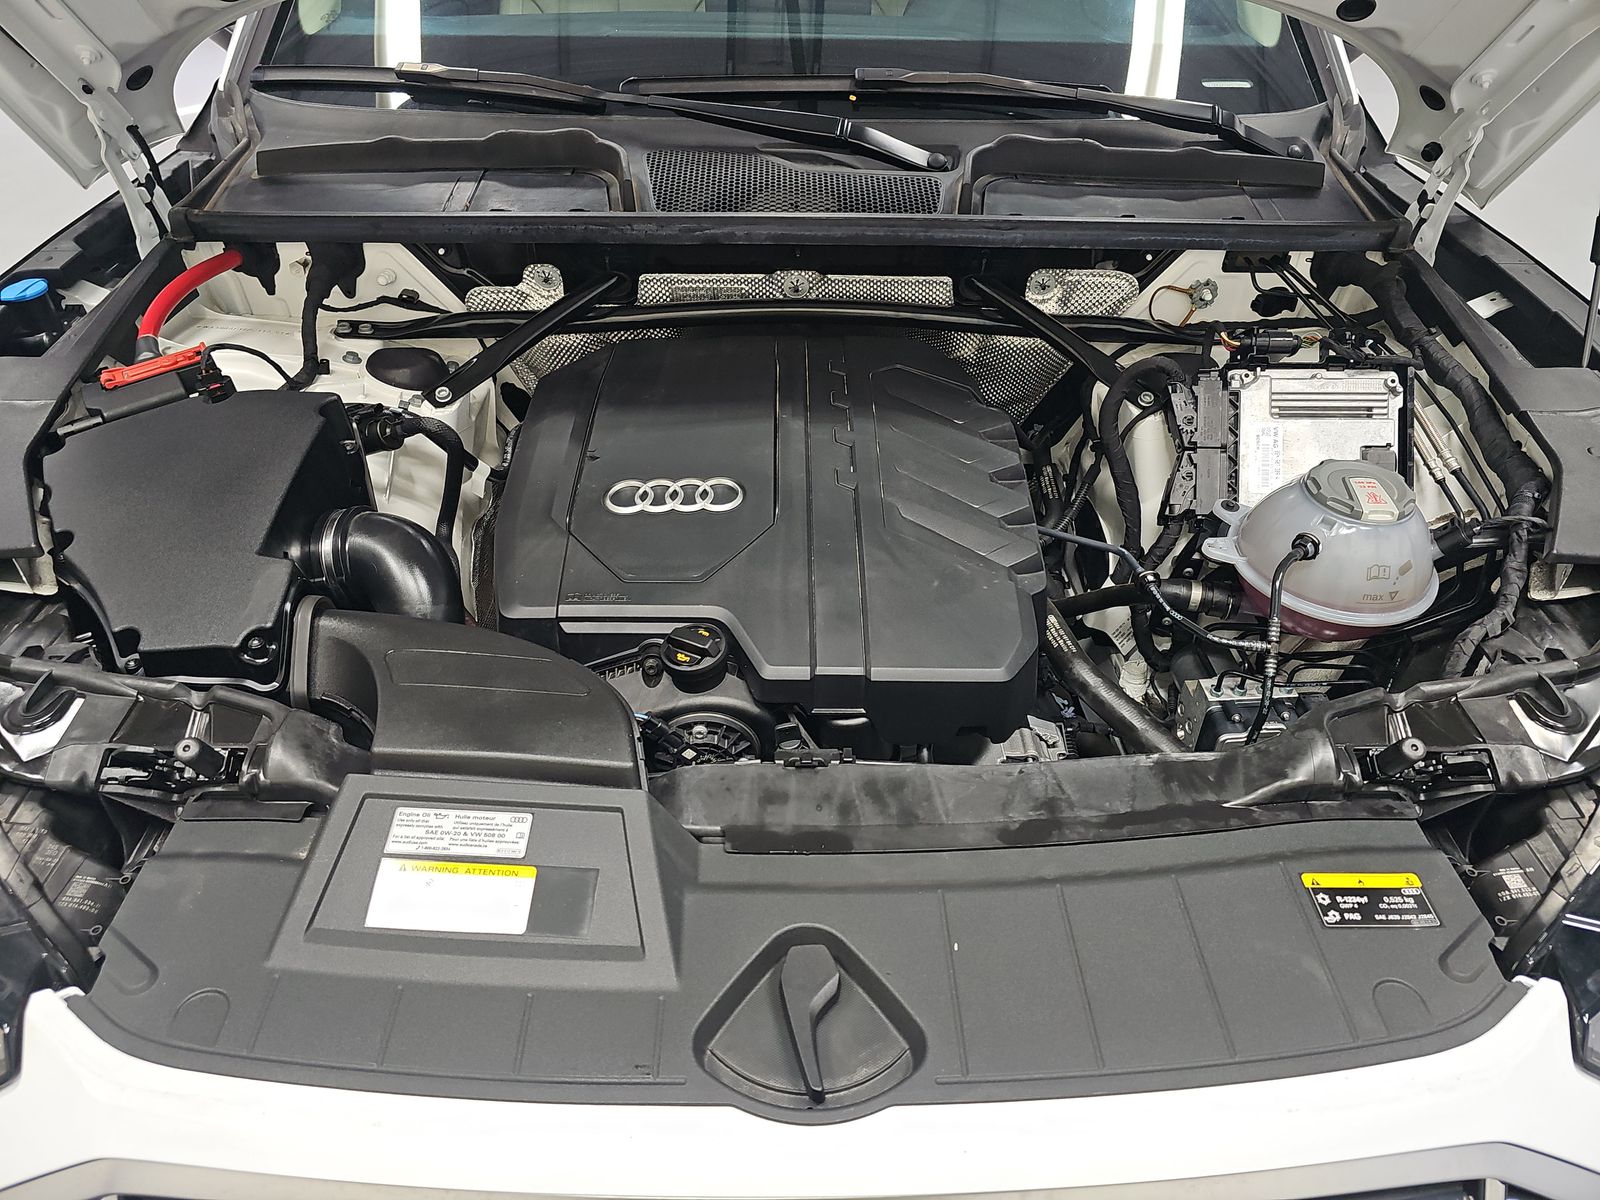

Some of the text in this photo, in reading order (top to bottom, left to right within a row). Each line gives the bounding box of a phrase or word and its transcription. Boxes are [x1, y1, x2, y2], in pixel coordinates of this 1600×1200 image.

[1362, 593, 1384, 601] max
[411, 864, 520, 877] WARNING ATTENTION
[1403, 896, 1415, 904] kg
[1343, 912, 1362, 920] PAG
